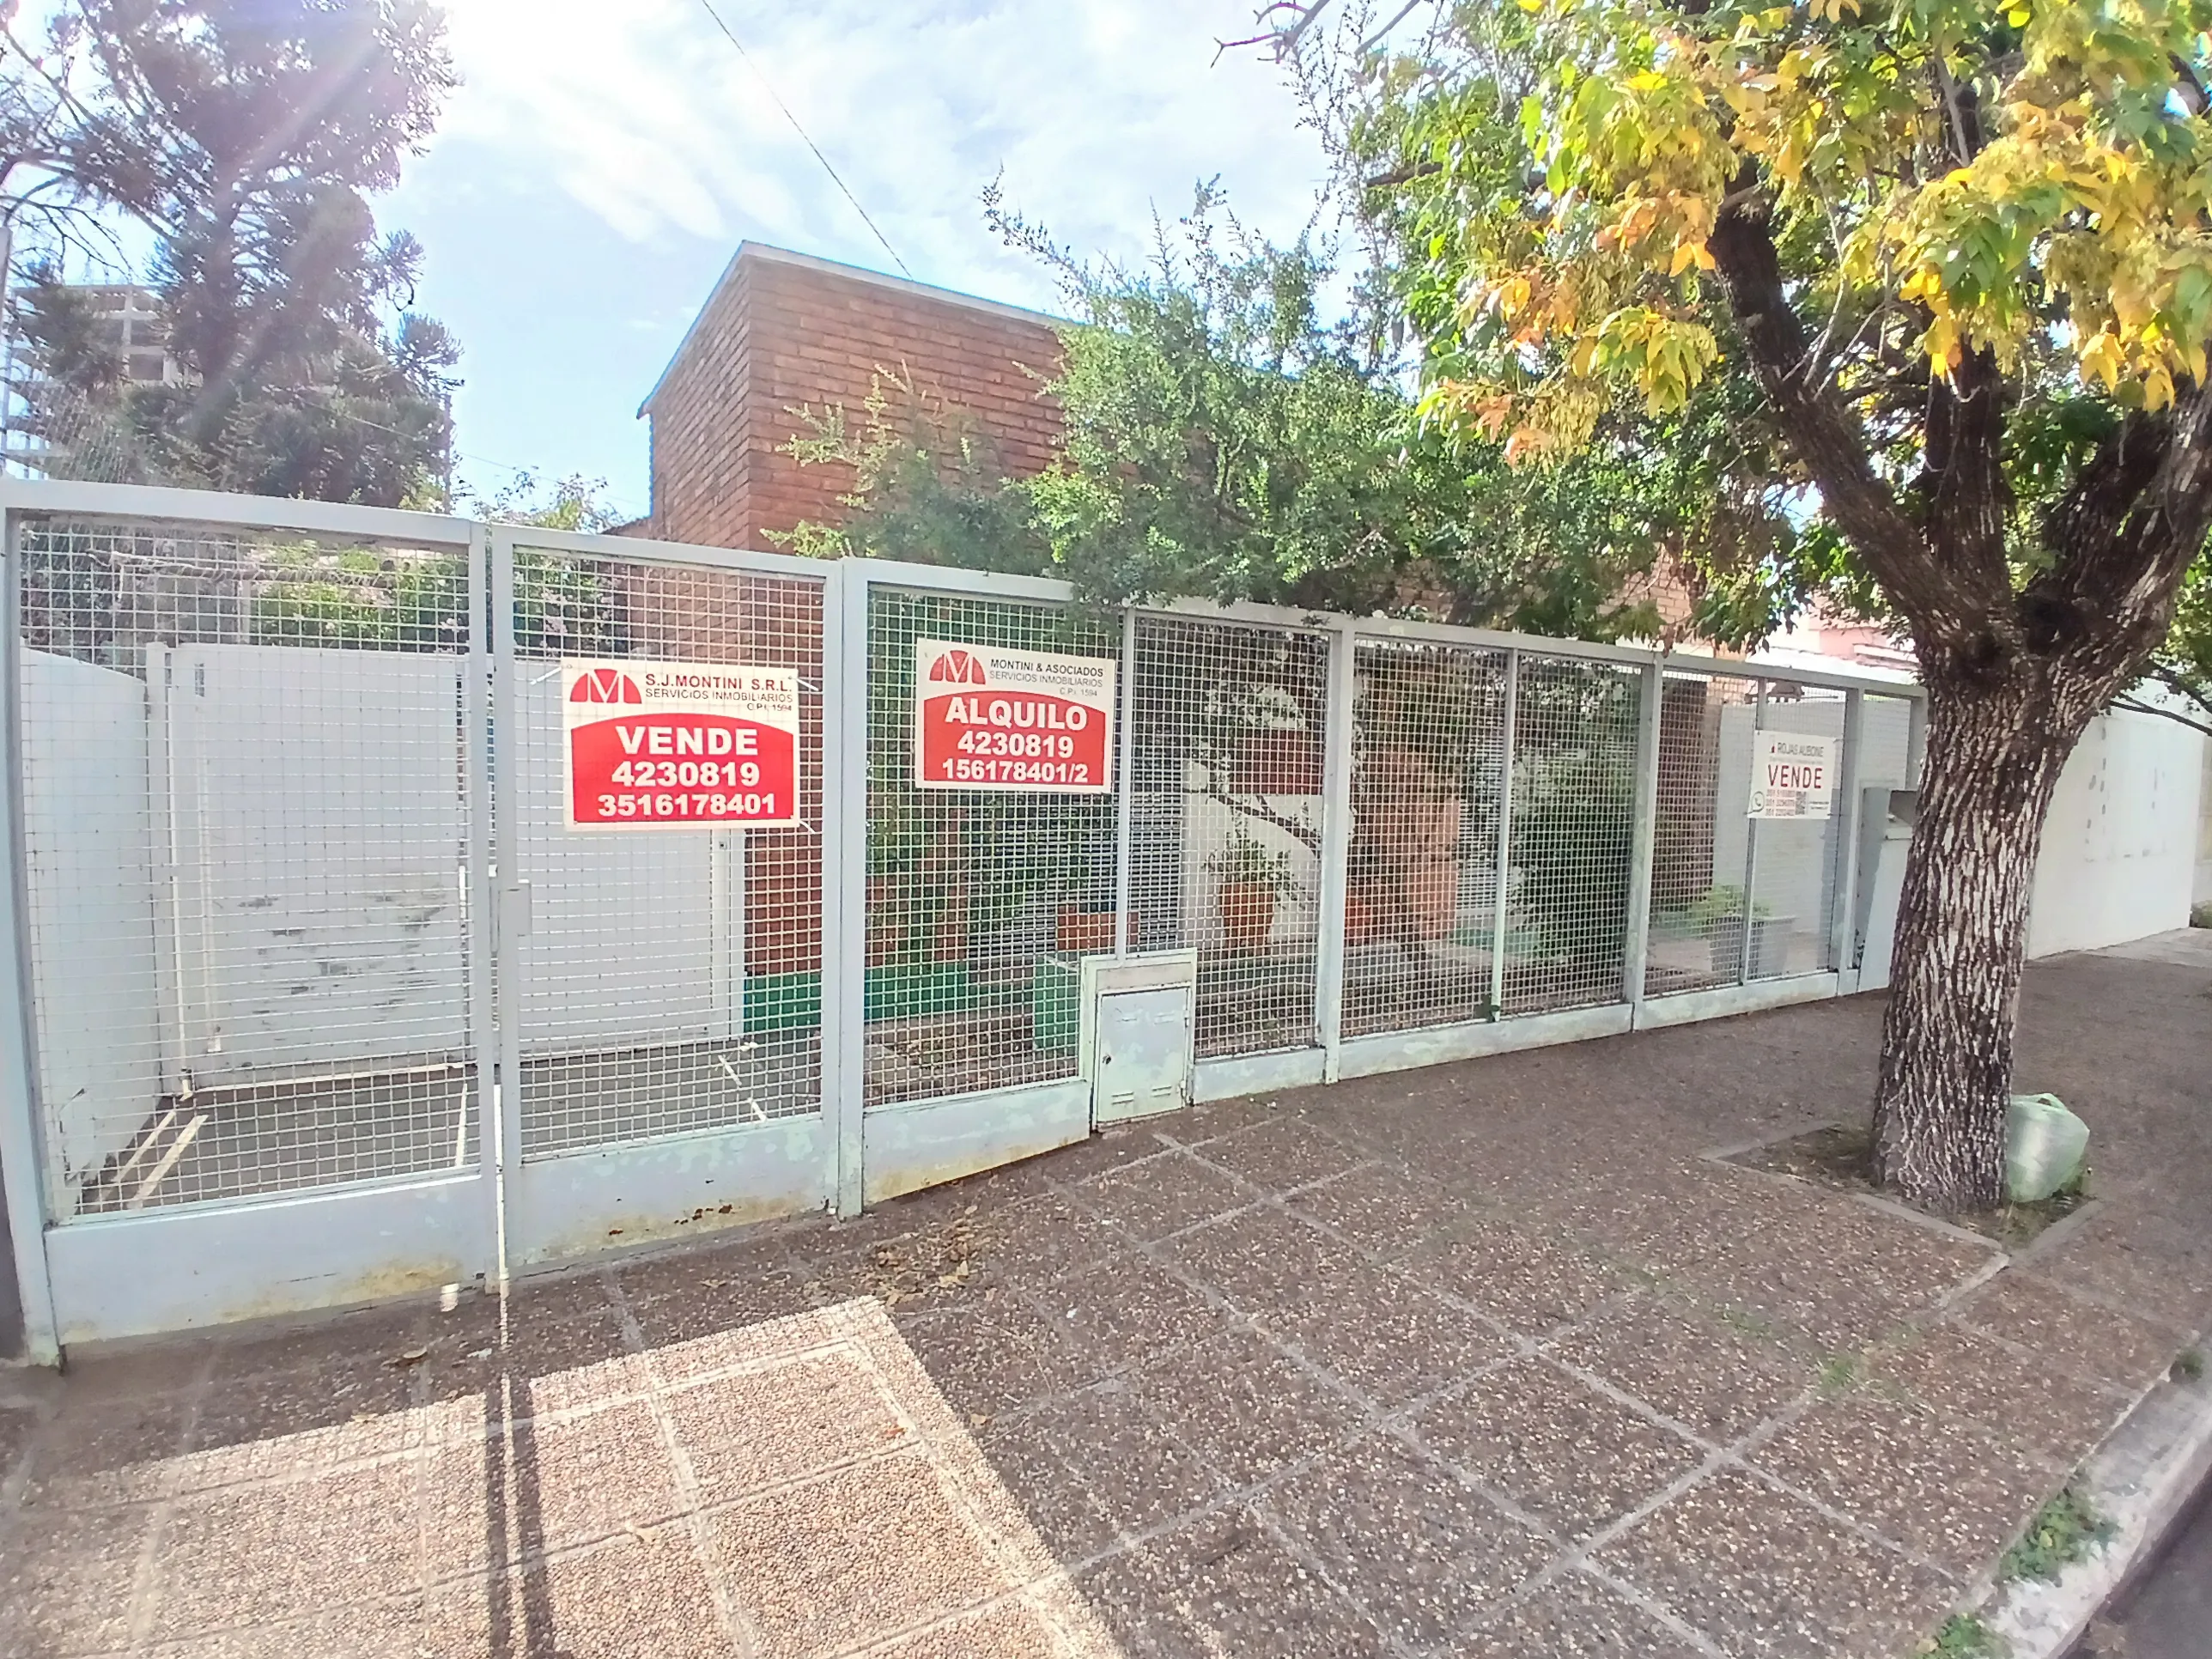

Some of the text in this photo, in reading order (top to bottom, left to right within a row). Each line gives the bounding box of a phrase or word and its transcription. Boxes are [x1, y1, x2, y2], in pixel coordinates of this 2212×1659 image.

[989, 671, 1103, 688] SERVICIOS INMOBILIARIOS
[990, 659, 1103, 678] MONTINI & ASOCIADOS
[646, 688, 793, 703] SERVICIOS INMOBILIARIOS
[751, 678, 792, 692] S.R.L.
[945, 696, 1087, 731] ALQUILO
[615, 726, 758, 756] VENDE
[957, 731, 1074, 758] 4230819
[611, 761, 760, 787] 4230819
[943, 758, 1089, 783] 156178401/2
[1768, 764, 1822, 789] VENDE
[598, 793, 775, 817] 3516178401
